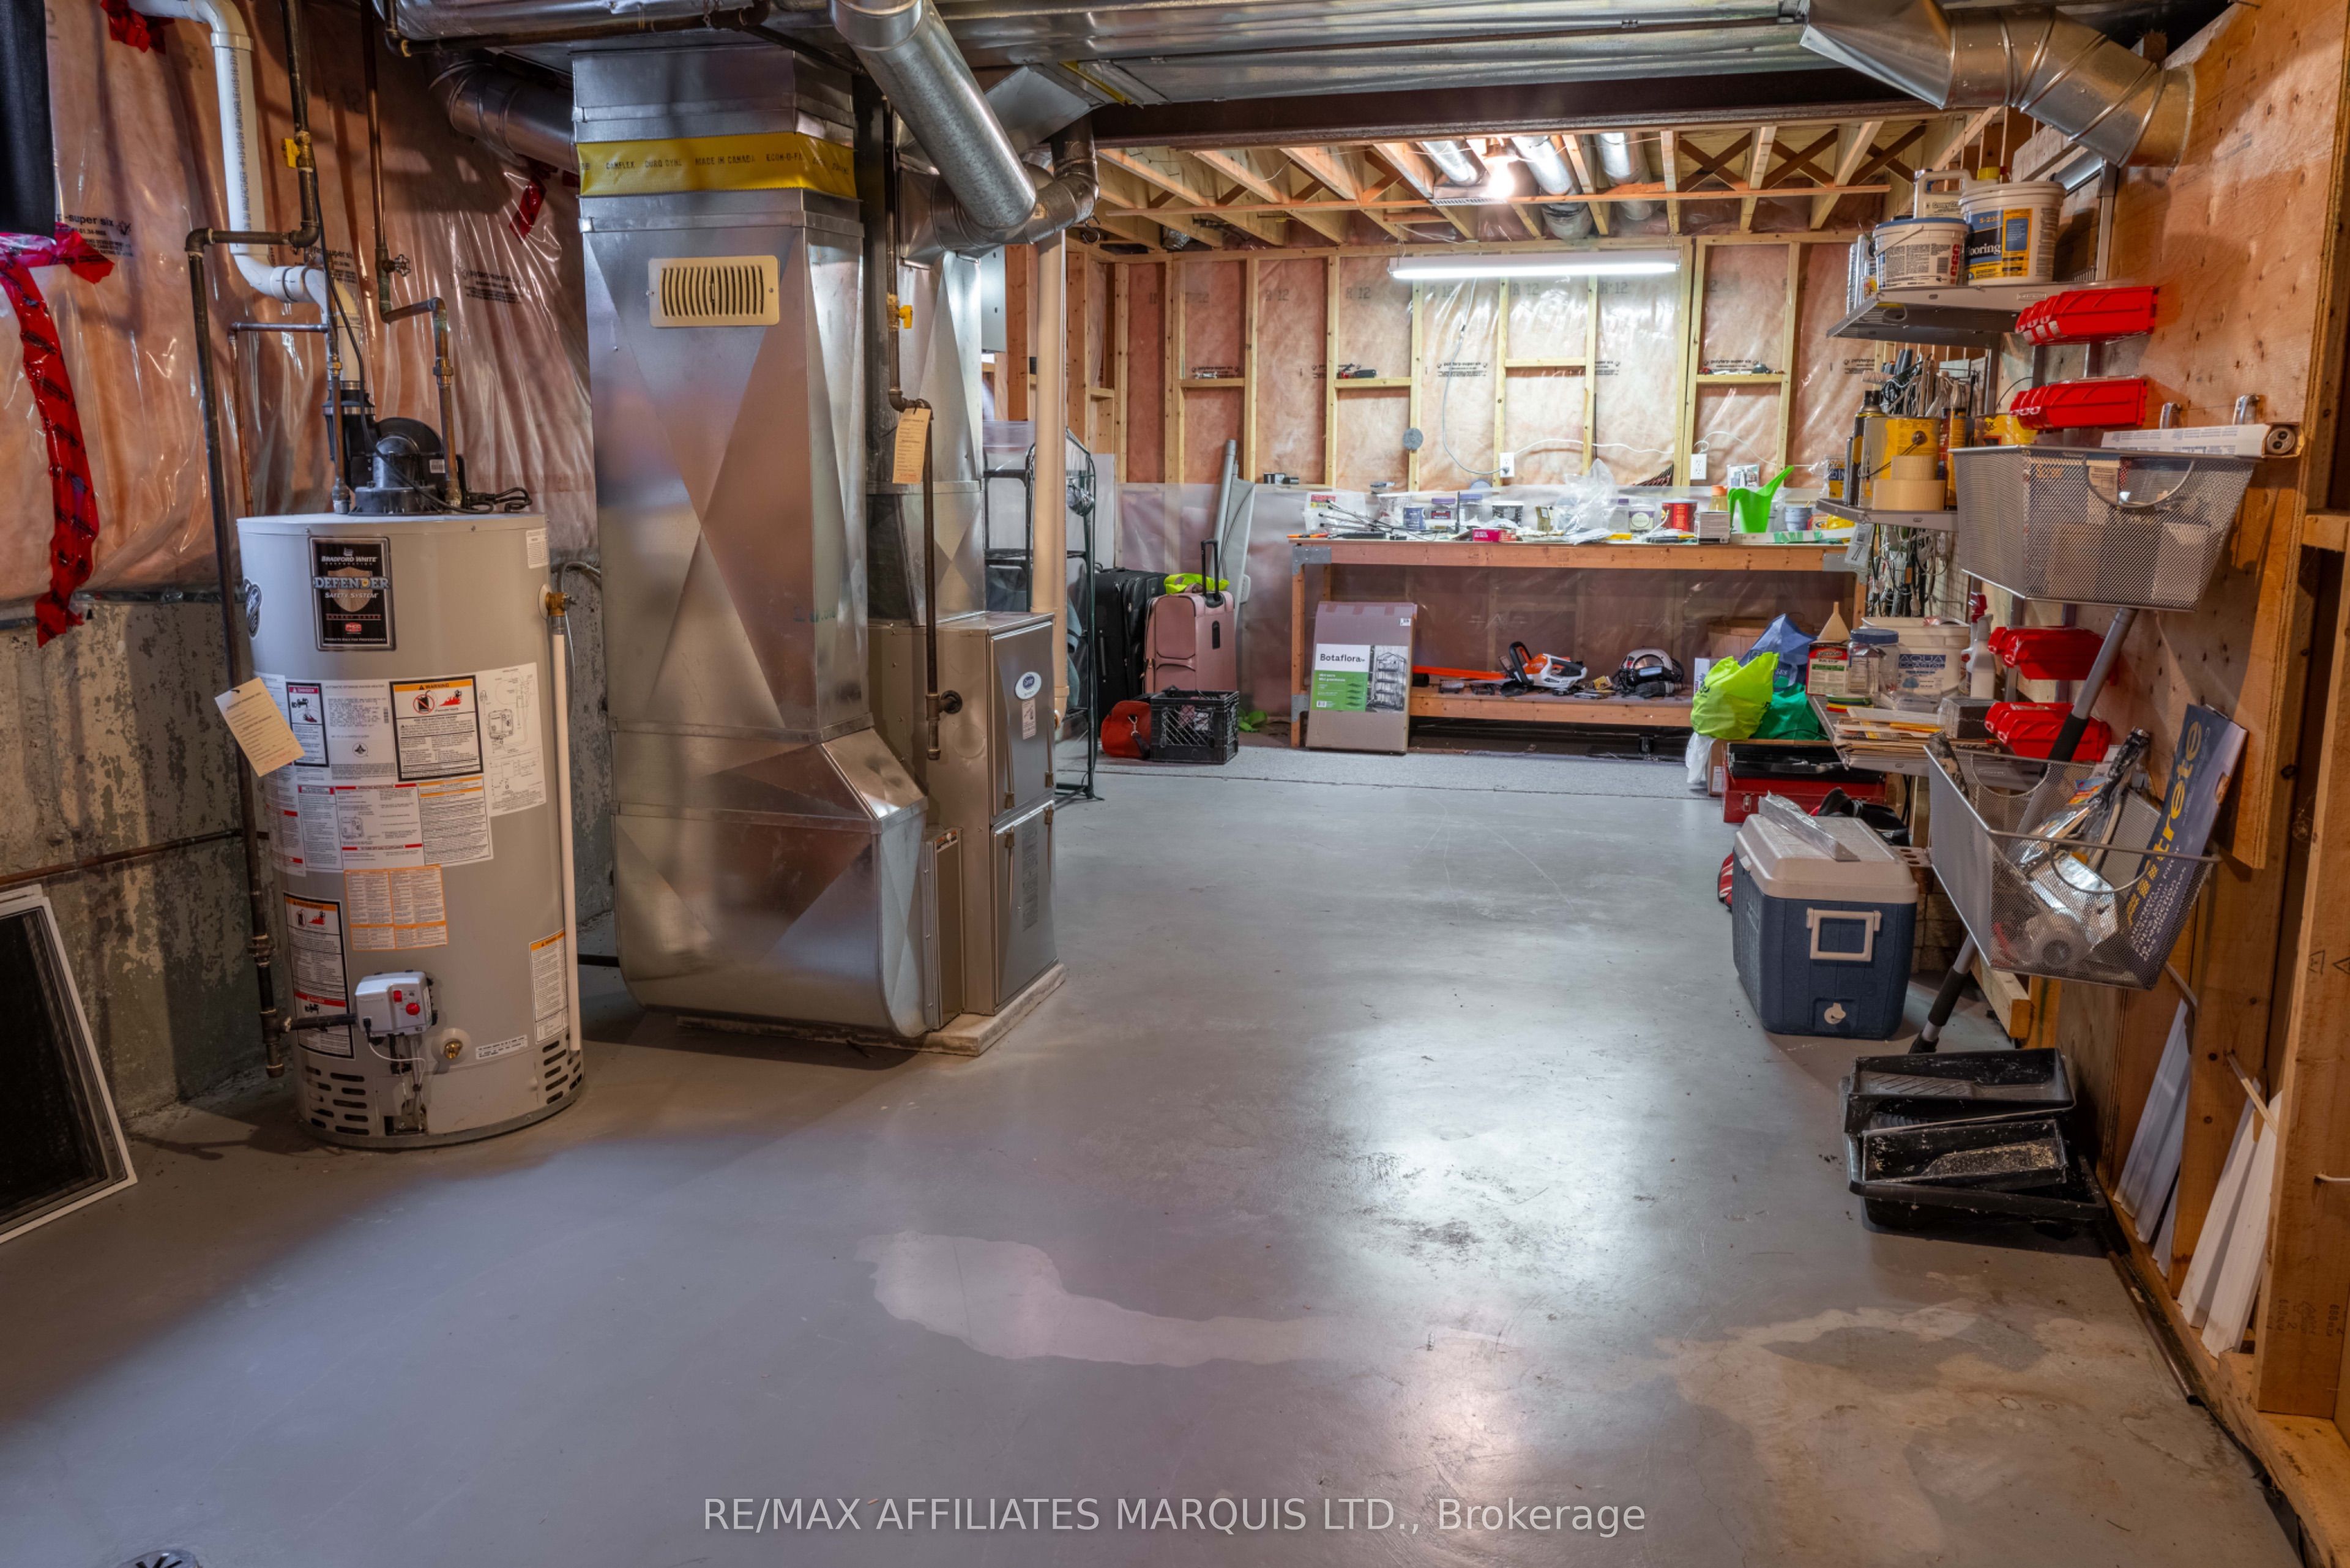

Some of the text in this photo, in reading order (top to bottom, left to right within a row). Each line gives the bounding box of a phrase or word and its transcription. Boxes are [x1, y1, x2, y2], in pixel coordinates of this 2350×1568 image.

[695, 155, 755, 166] MADE IN CANADA
[1967, 242, 2001, 256] looring
[313, 577, 389, 589] DEFENDER
[1320, 653, 1360, 662] Botaflora
